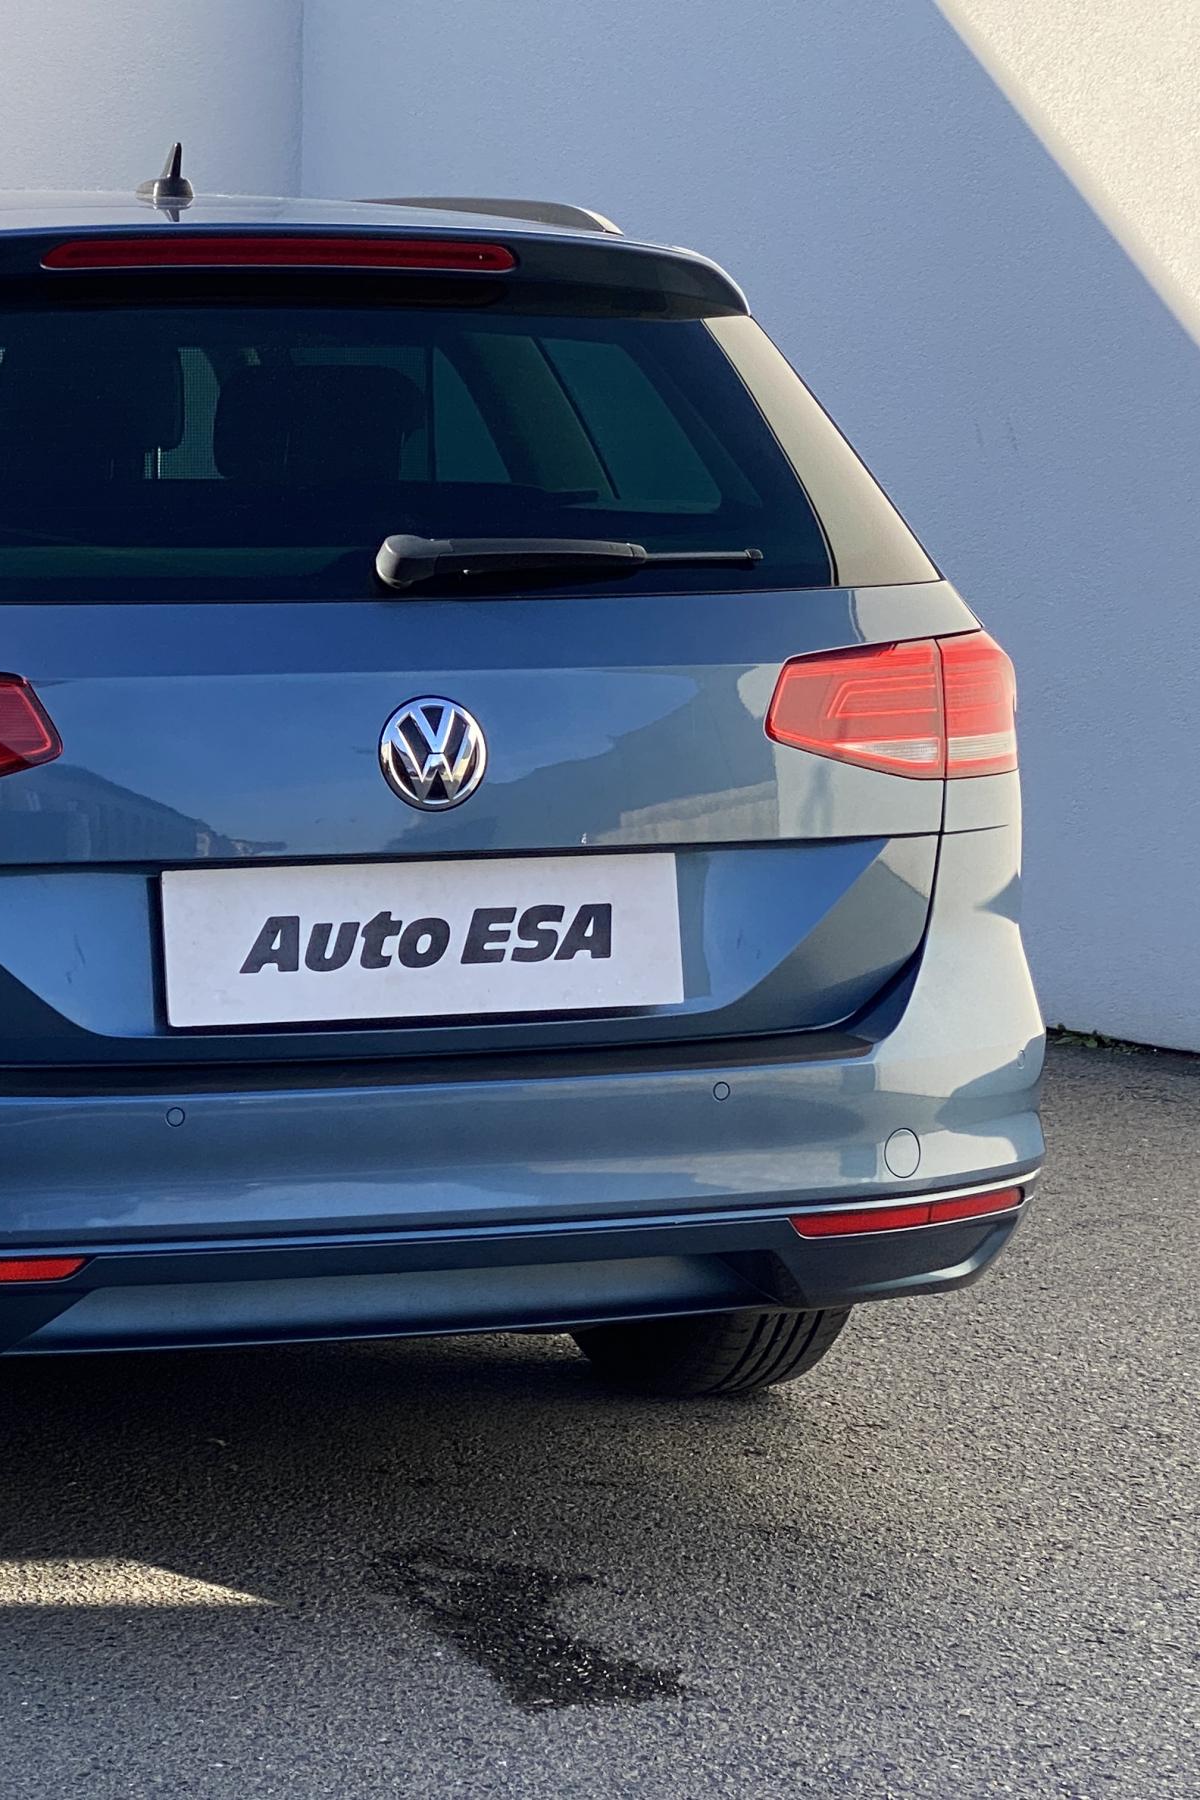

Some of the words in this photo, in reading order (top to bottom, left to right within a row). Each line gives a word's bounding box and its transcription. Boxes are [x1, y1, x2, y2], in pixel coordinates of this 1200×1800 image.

[381, 697, 486, 809] VW
[239, 911, 451, 974] Auto
[460, 903, 612, 964] ESA
